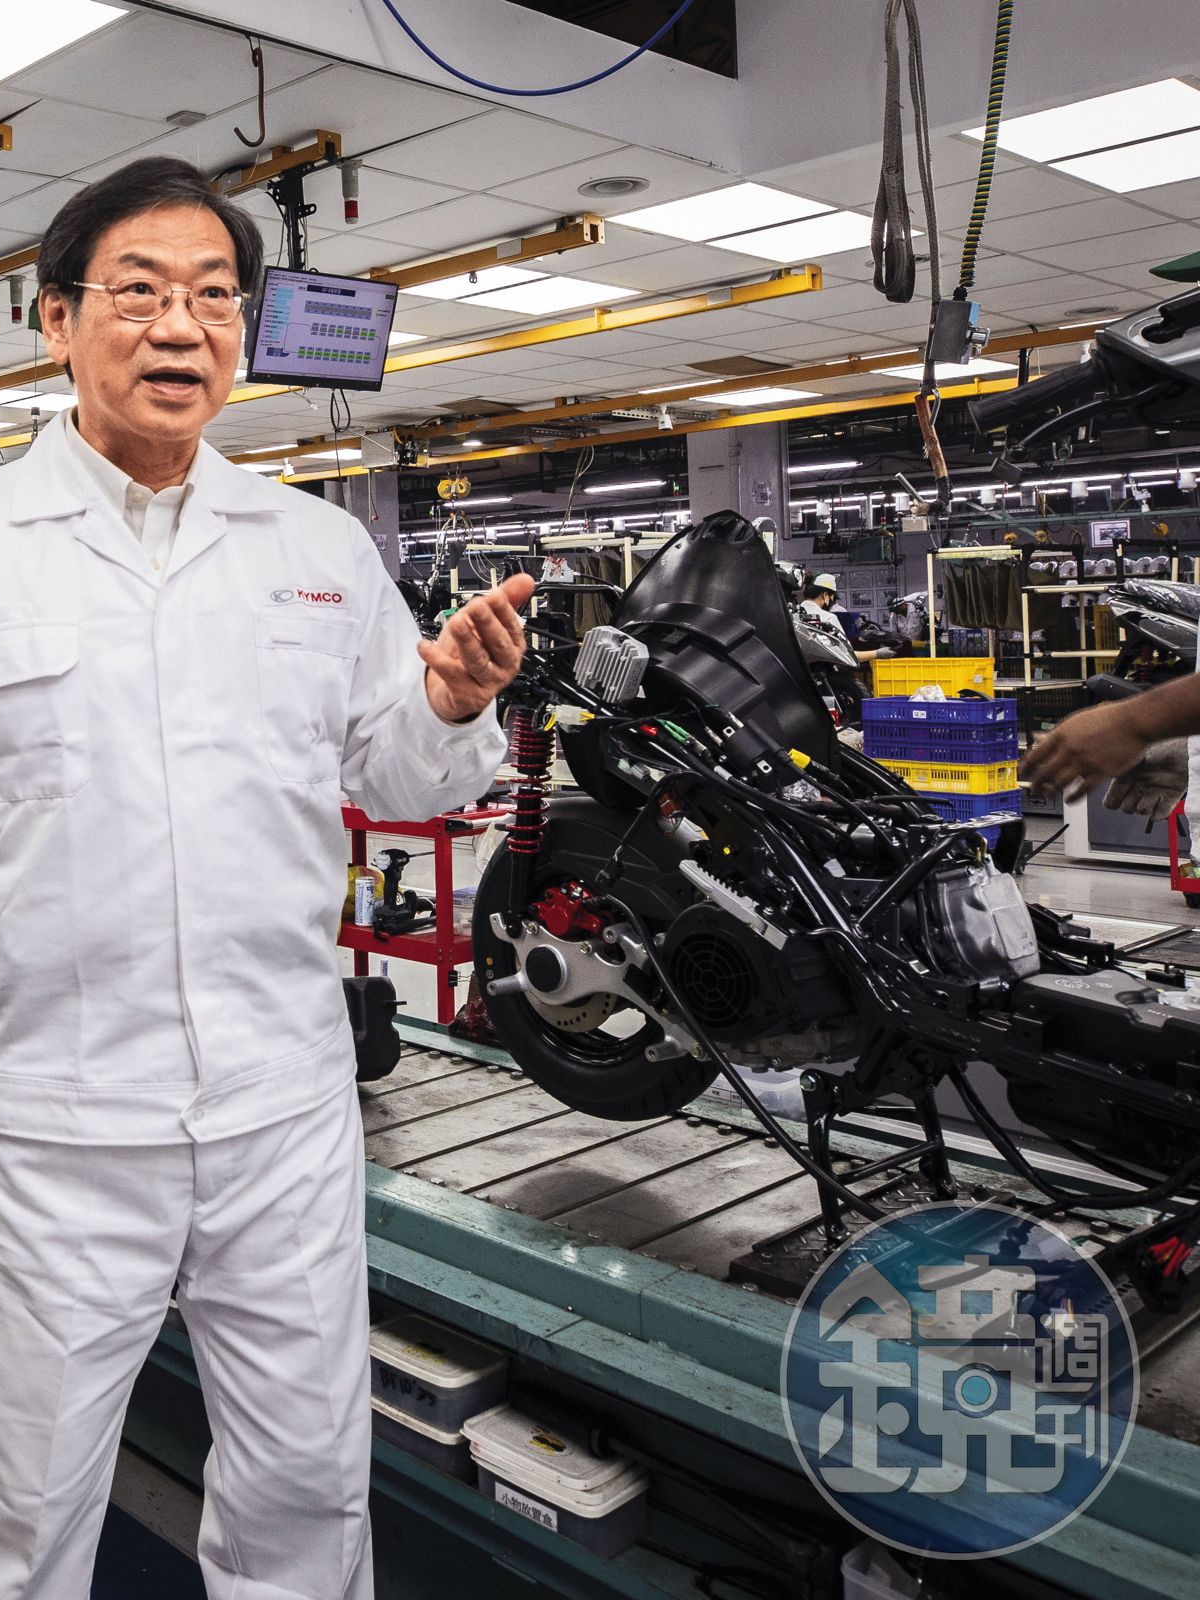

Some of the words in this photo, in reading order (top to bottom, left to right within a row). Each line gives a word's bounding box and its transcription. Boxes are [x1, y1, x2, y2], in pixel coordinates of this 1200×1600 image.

[297, 589, 342, 603] KYMCO
[501, 1493, 553, 1528] 小物放置盒
